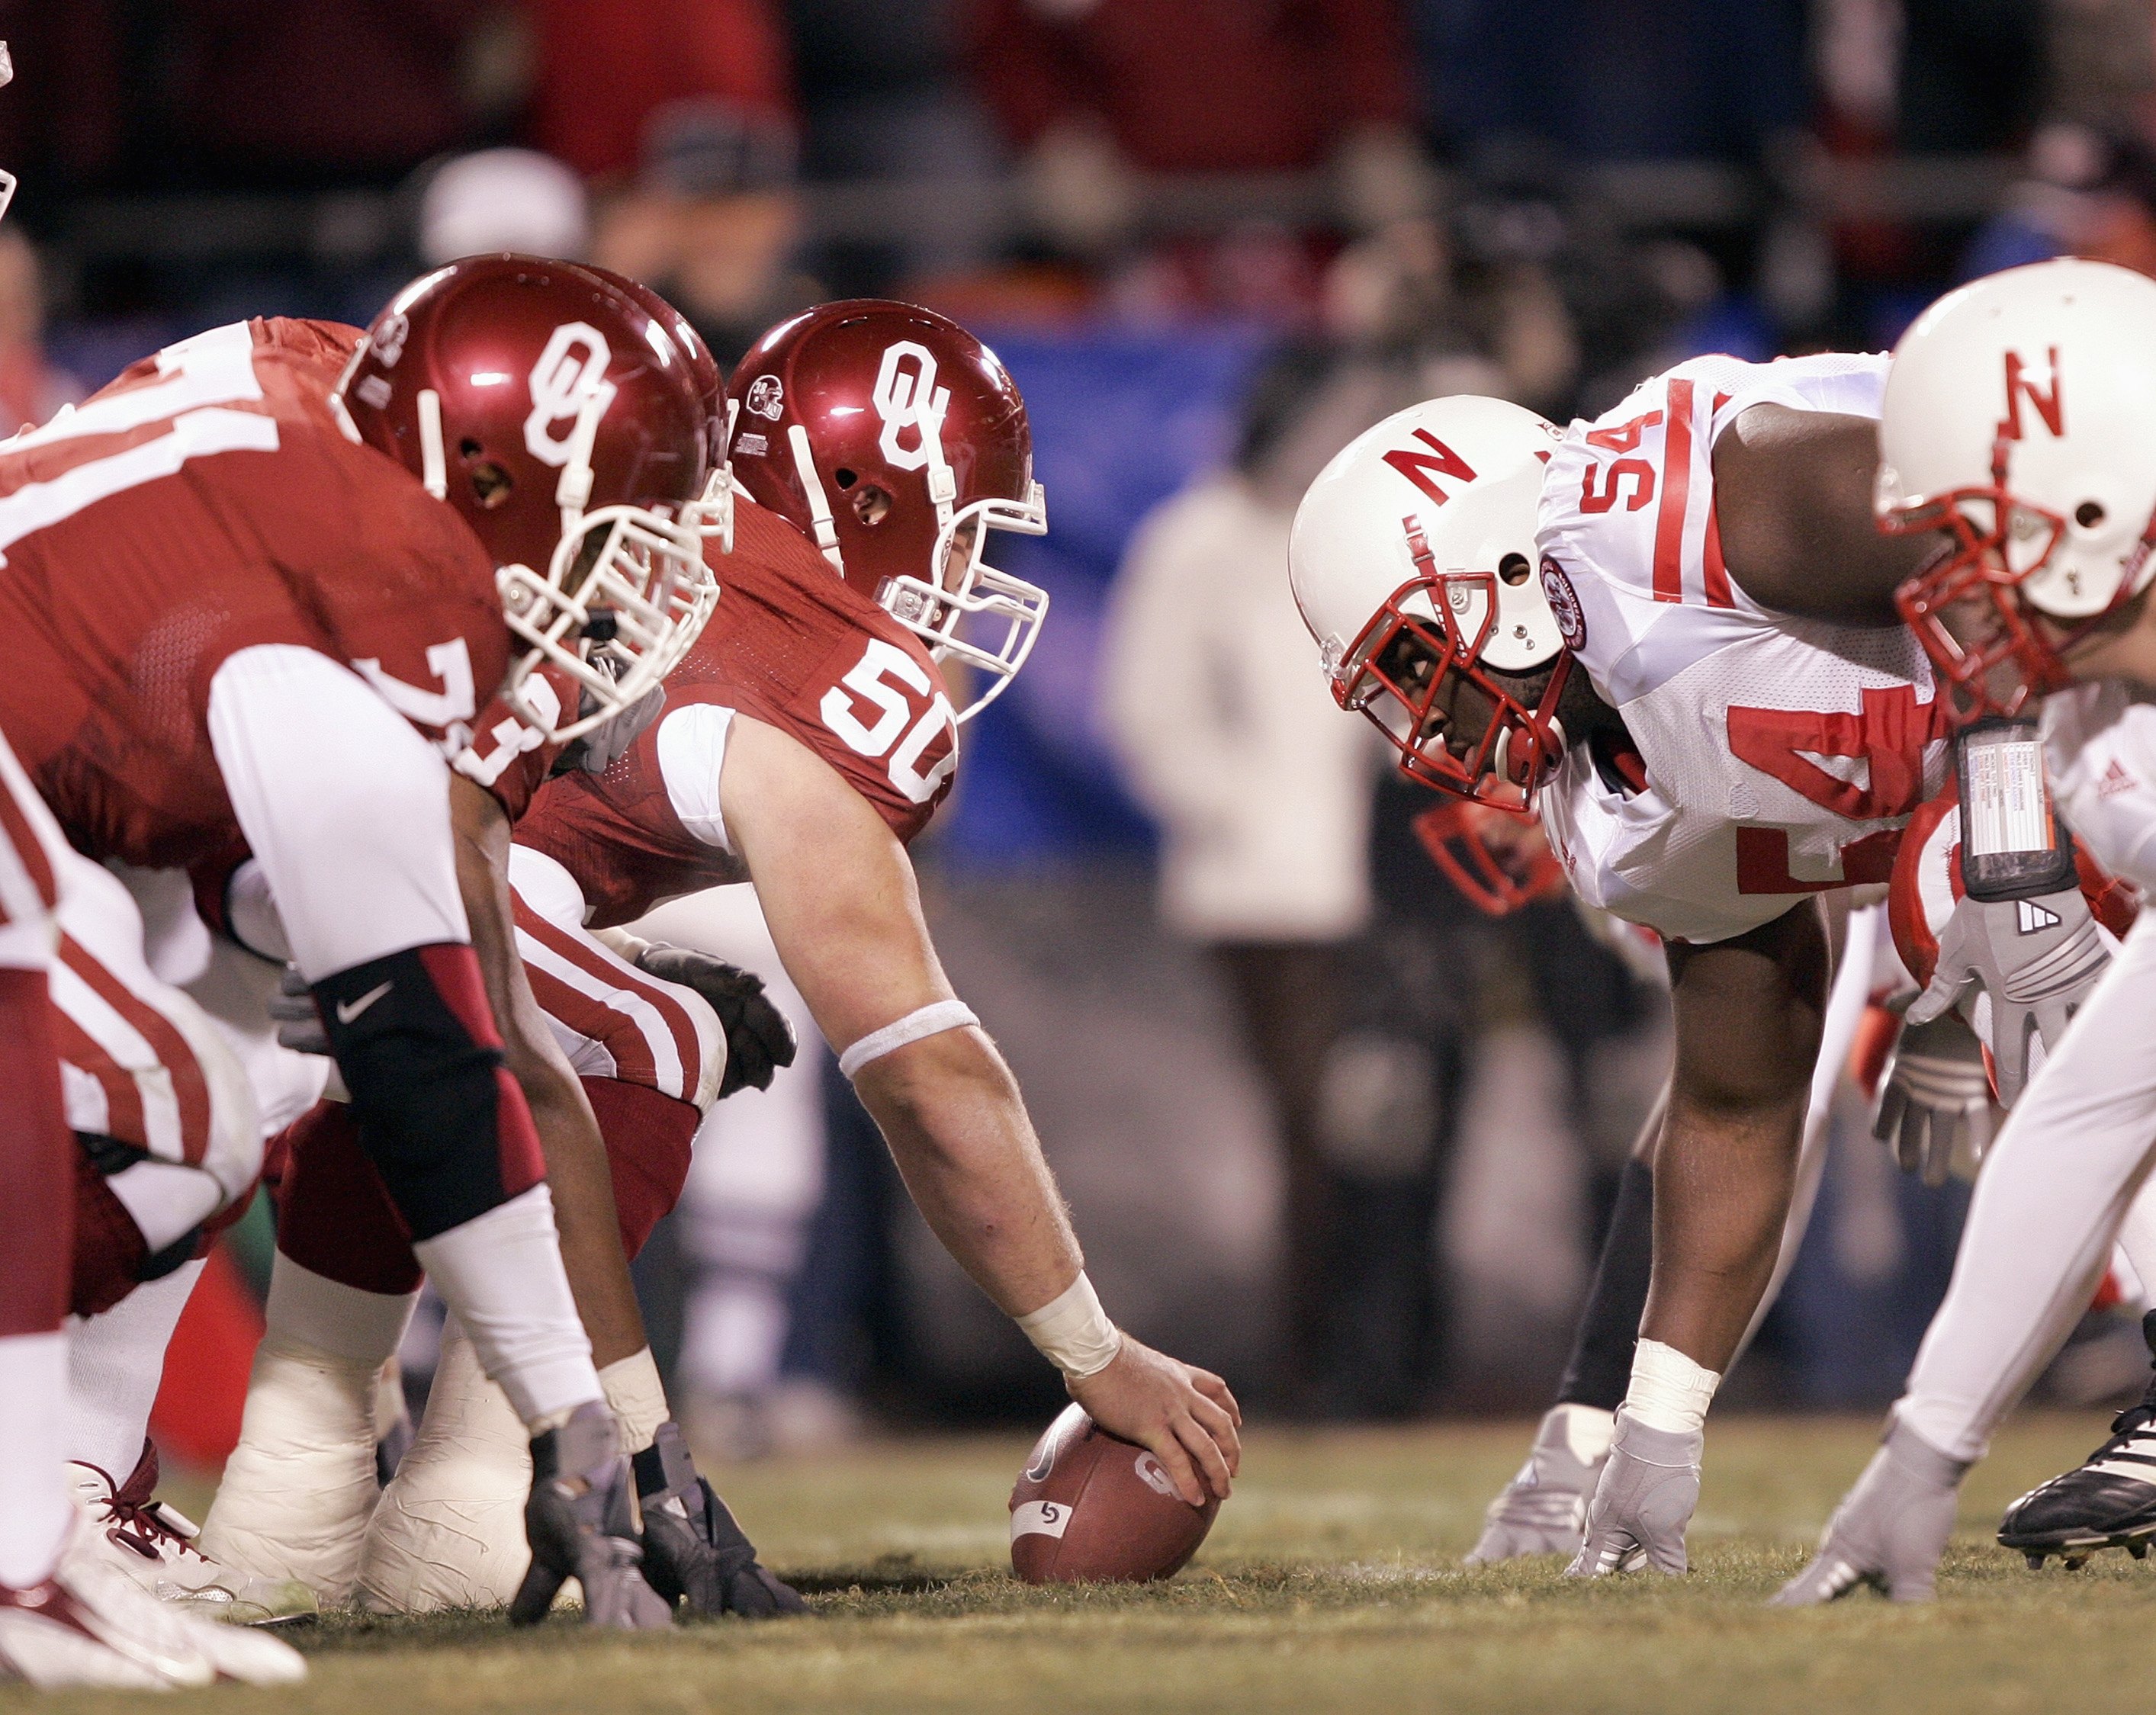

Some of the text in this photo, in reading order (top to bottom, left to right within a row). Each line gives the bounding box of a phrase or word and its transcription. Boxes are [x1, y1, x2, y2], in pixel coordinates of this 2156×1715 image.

[523, 320, 618, 467] OU
[872, 340, 950, 471] OU
[2006, 346, 2064, 440] N
[1381, 428, 1478, 507] N
[1579, 409, 1663, 513] 54
[819, 638, 959, 805] 50
